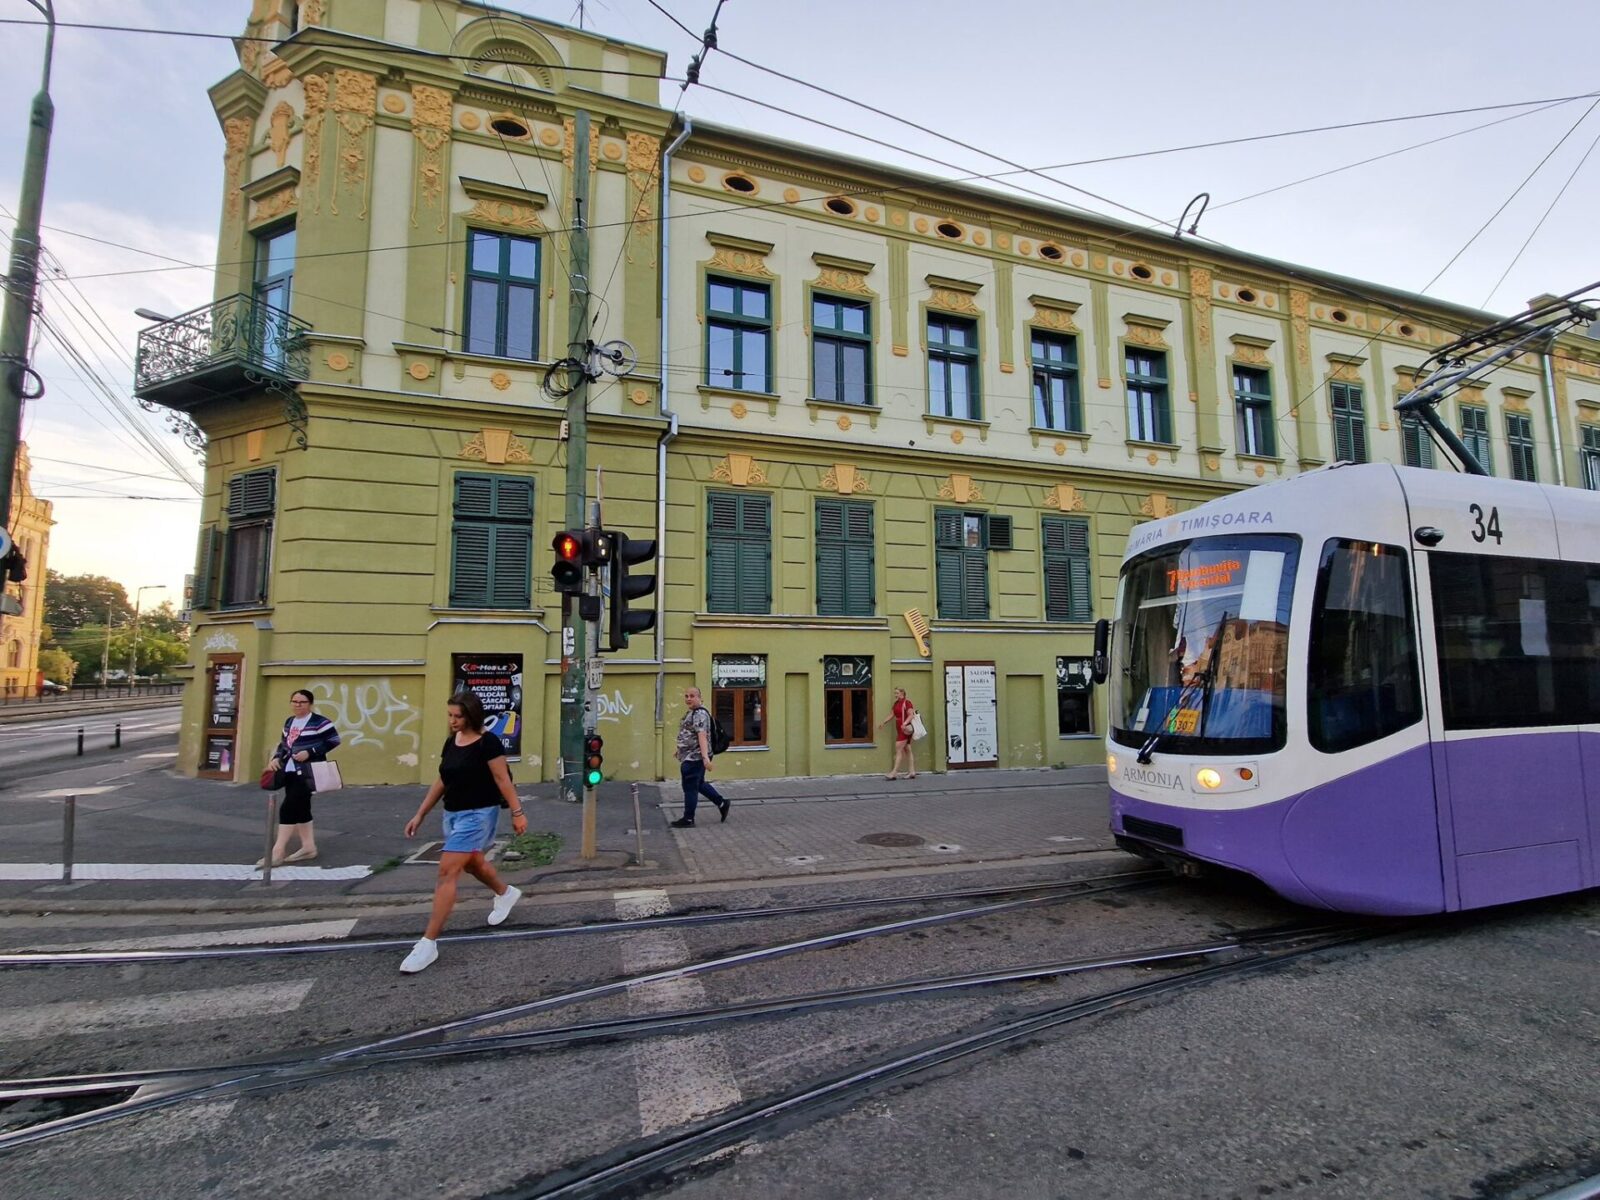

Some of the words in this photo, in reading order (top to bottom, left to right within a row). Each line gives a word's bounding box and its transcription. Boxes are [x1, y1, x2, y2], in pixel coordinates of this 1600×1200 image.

[1181, 511, 1273, 531] TIMIȘOARA
[1469, 503, 1503, 545] 34
[1123, 767, 1185, 790] ARMONIA
